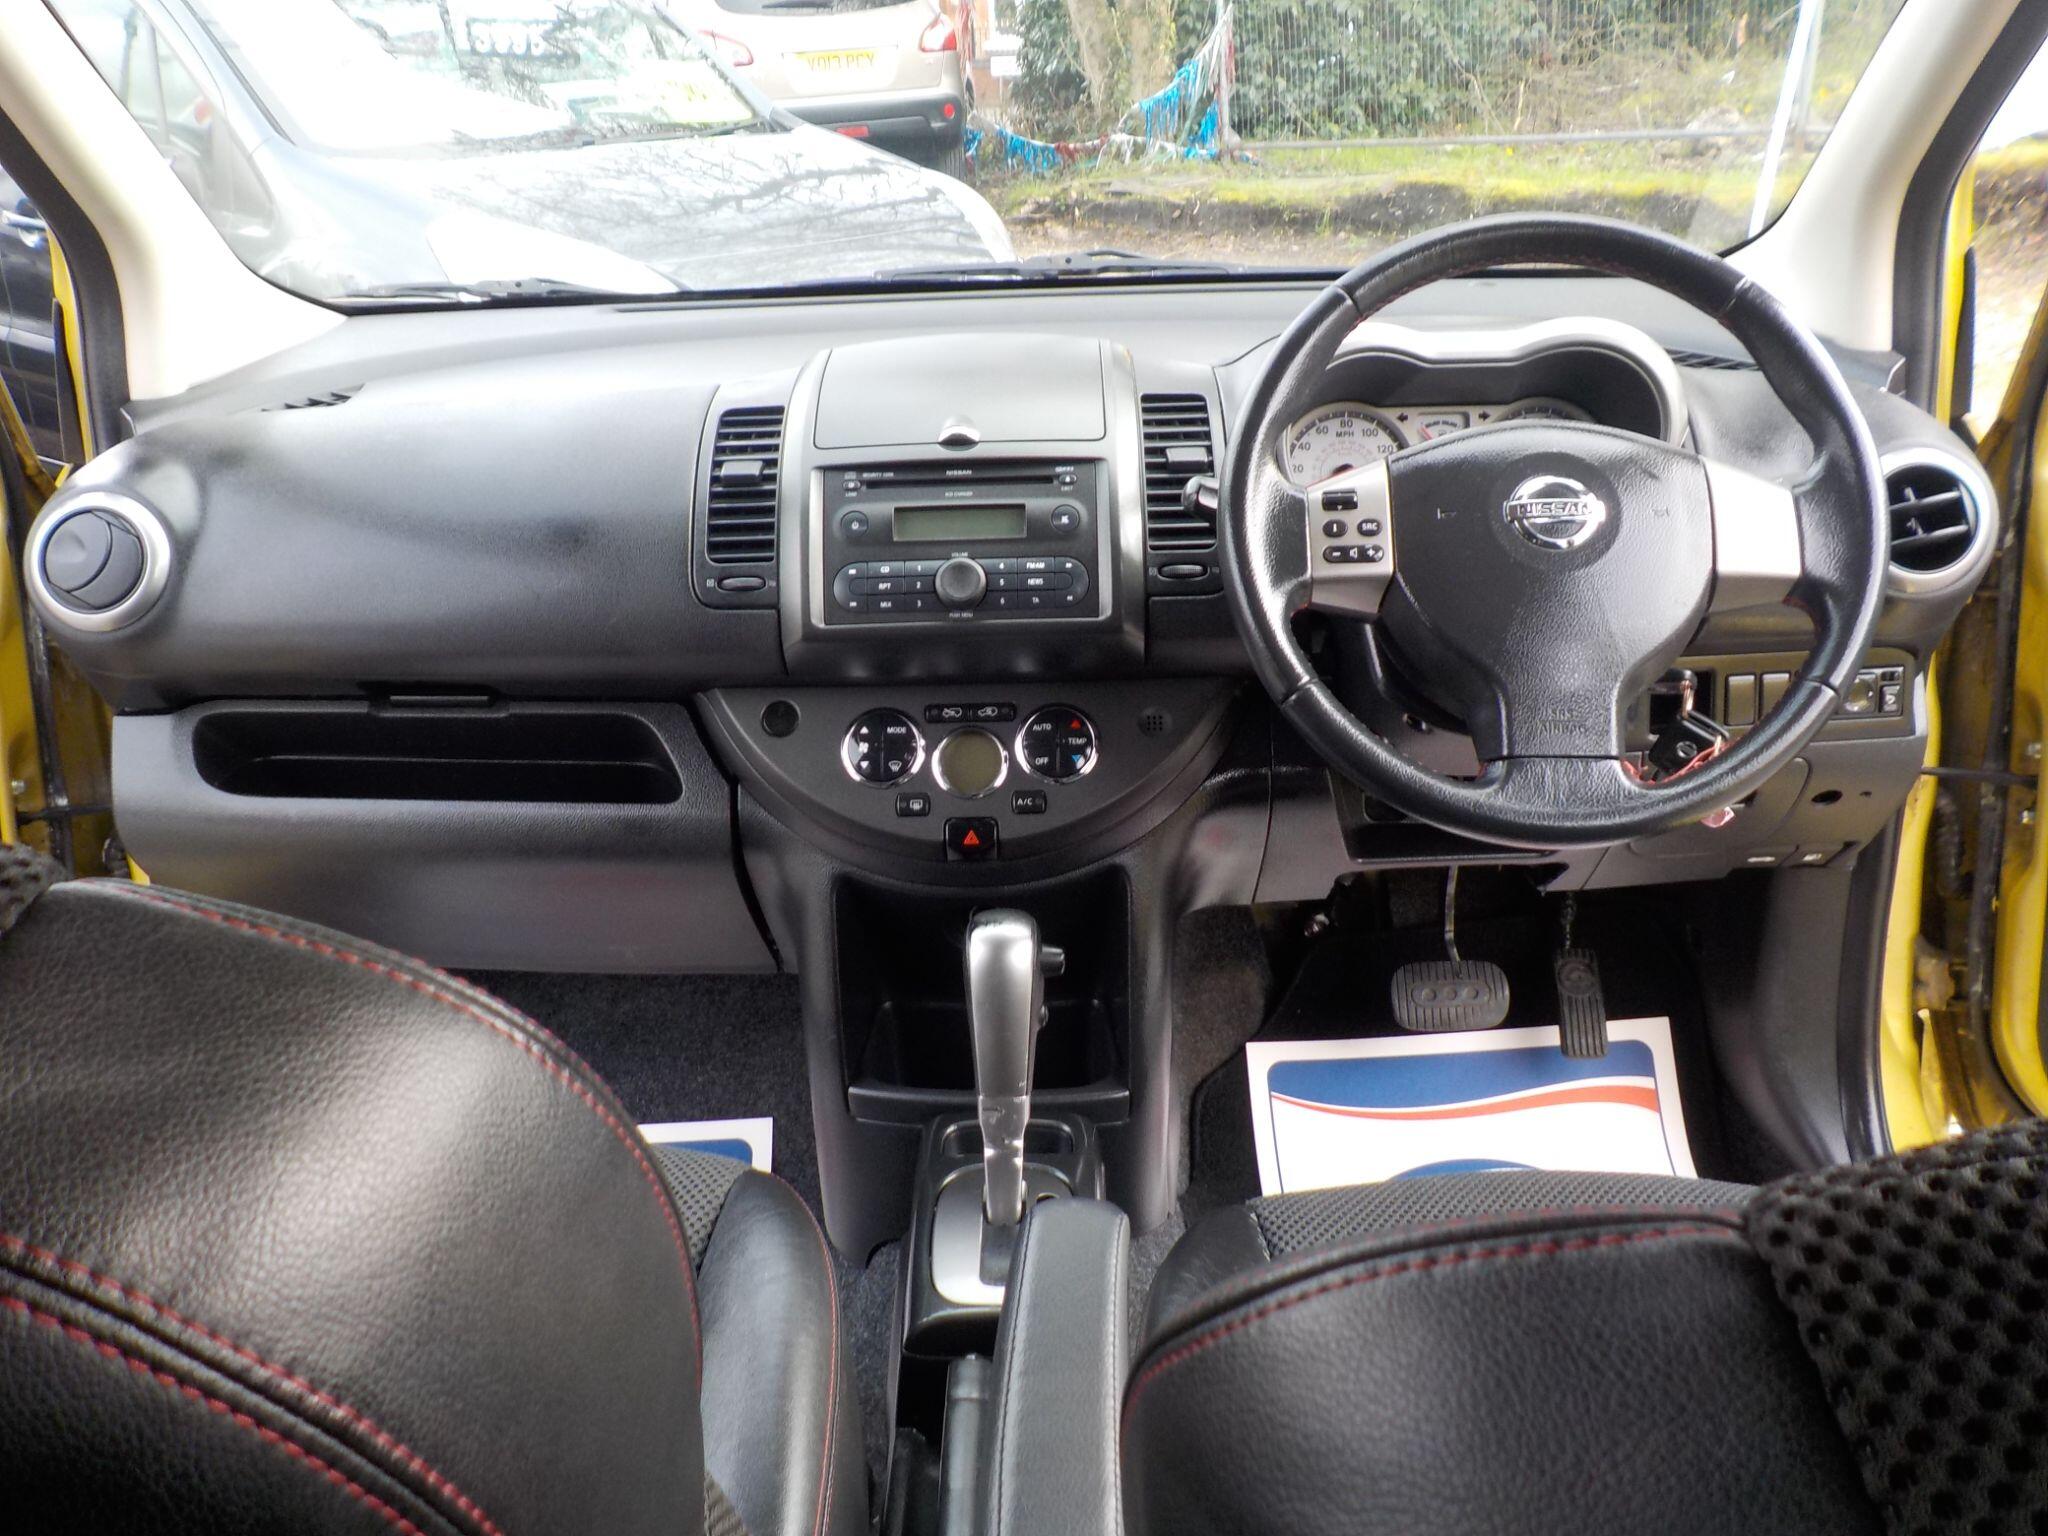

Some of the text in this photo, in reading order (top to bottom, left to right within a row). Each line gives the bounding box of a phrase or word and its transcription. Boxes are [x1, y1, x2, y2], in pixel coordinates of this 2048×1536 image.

[1340, 418, 1354, 429] 80
[1315, 425, 1329, 435] 60
[1335, 430, 1355, 438] MPH
[1361, 427, 1379, 438] 100
[1297, 441, 1312, 452] 40
[1376, 443, 1395, 454] 120
[945, 469, 973, 477] NISSAN
[1291, 464, 1304, 474] 20
[1516, 501, 1593, 517] NISSAN
[1361, 522, 1378, 531] SRC
[880, 565, 890, 574] CD
[878, 582, 891, 590] RPT
[916, 581, 921, 589] 2
[1000, 578, 1005, 586] 5
[1027, 577, 1044, 586] NEWS
[917, 600, 922, 608] 3
[1000, 597, 1005, 605] 6
[1032, 596, 1040, 604] TA
[886, 726, 907, 734] MODE
[1032, 723, 1052, 732] AUTO
[1068, 737, 1088, 745] TEMP
[1035, 757, 1049, 766] OFF
[1017, 797, 1033, 806] A/C
